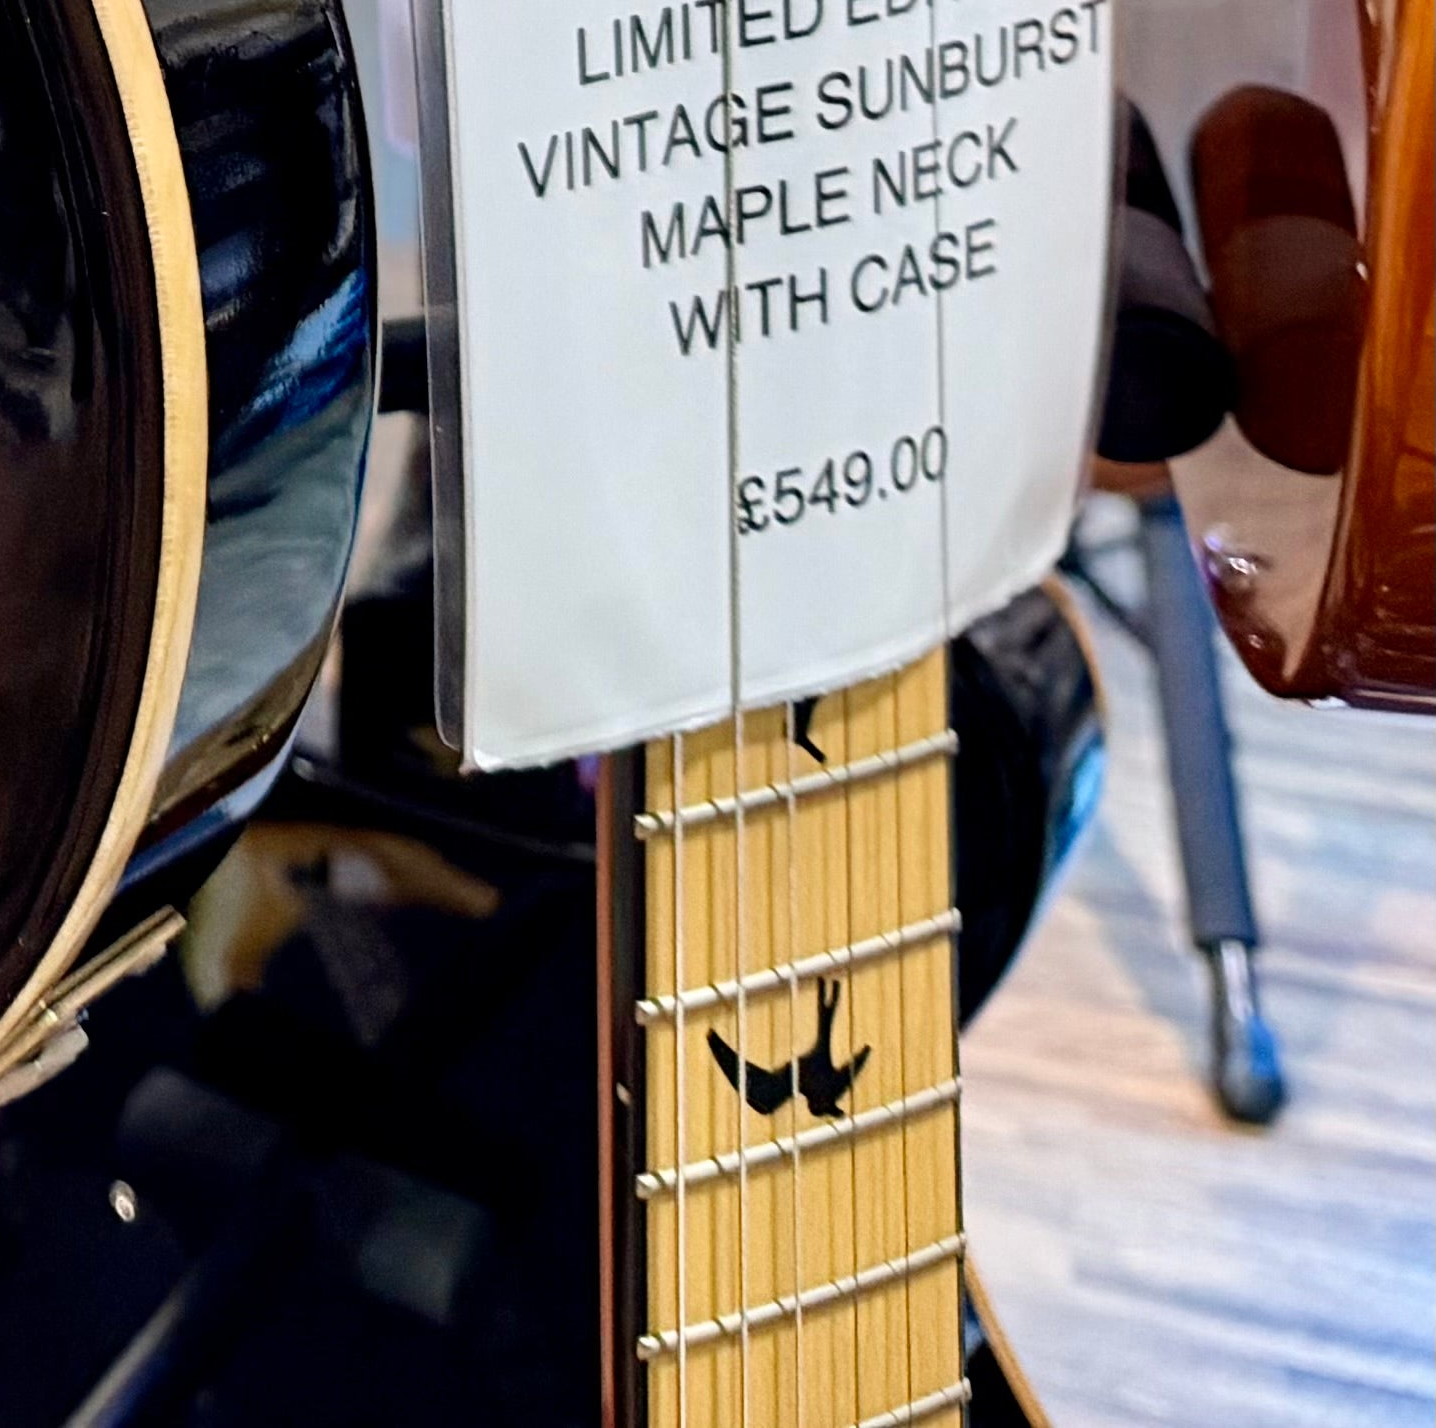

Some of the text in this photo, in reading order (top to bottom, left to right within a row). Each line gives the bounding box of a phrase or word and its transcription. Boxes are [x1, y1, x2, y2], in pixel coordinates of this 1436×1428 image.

[517, 82, 797, 199] VINTAGE
[639, 116, 1022, 270] MAPLE NECK
[669, 218, 998, 357] WITH CASE
[736, 424, 949, 536] £549.00
